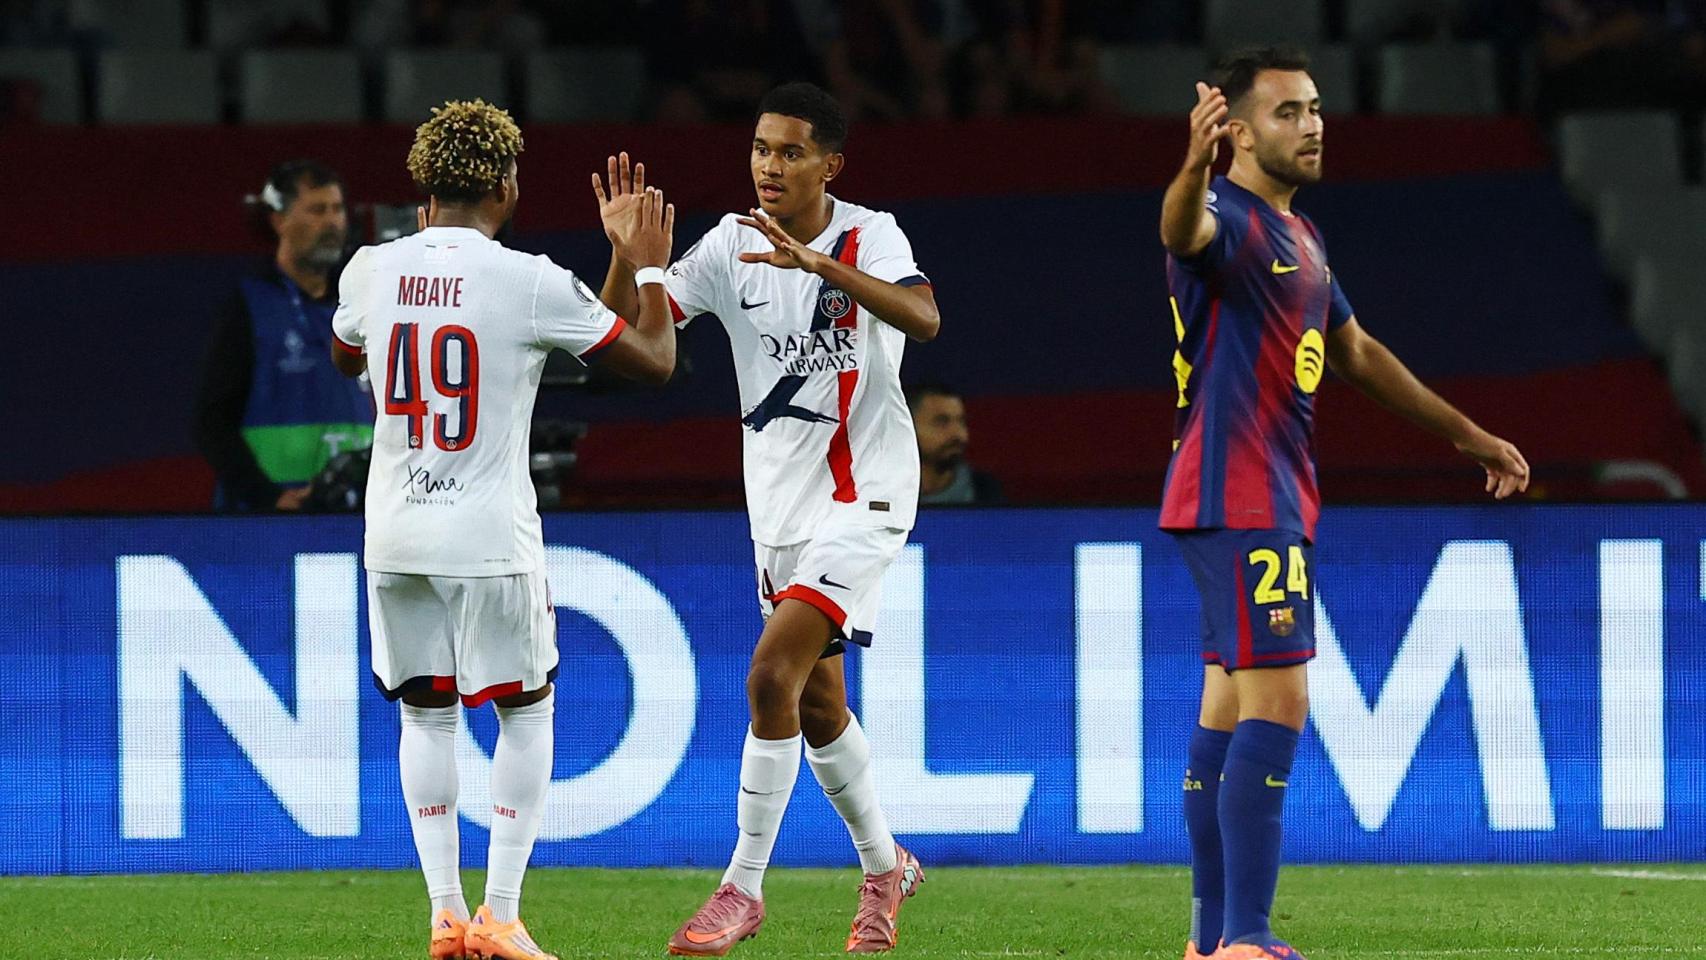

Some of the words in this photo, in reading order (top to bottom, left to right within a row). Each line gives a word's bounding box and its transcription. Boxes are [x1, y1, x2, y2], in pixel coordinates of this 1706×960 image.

[397, 275, 464, 308] MBAYE
[760, 328, 856, 362] QATAR
[385, 322, 480, 452] 49
[1248, 545, 1309, 605] 24
[115, 546, 697, 845] NO
[860, 538, 1706, 834] LIMI
[418, 804, 448, 819] PARIS
